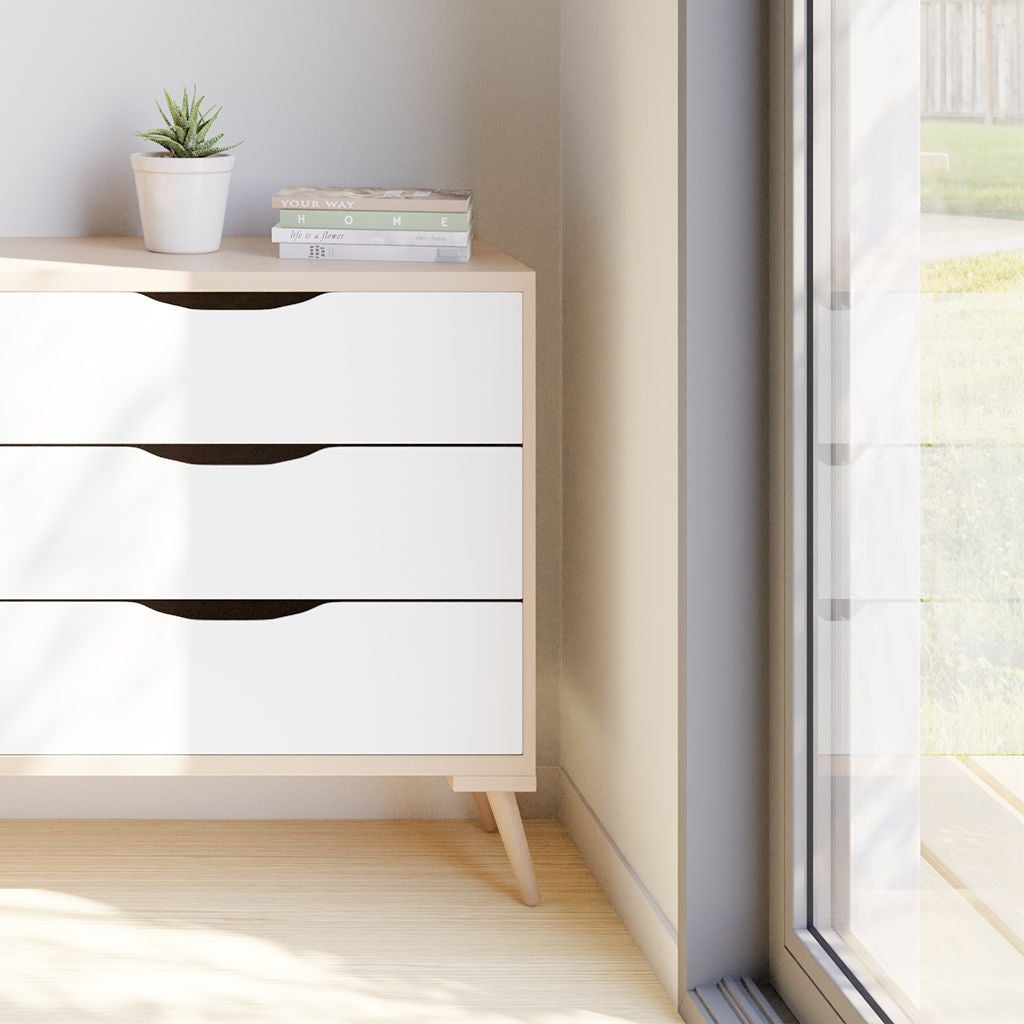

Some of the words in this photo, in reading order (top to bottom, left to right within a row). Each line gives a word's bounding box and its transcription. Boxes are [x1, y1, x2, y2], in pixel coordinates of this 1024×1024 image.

[280, 199, 321, 208] YOUR
[325, 200, 355, 209] WAY
[290, 230, 303, 241] life
[319, 231, 345, 242] flower
